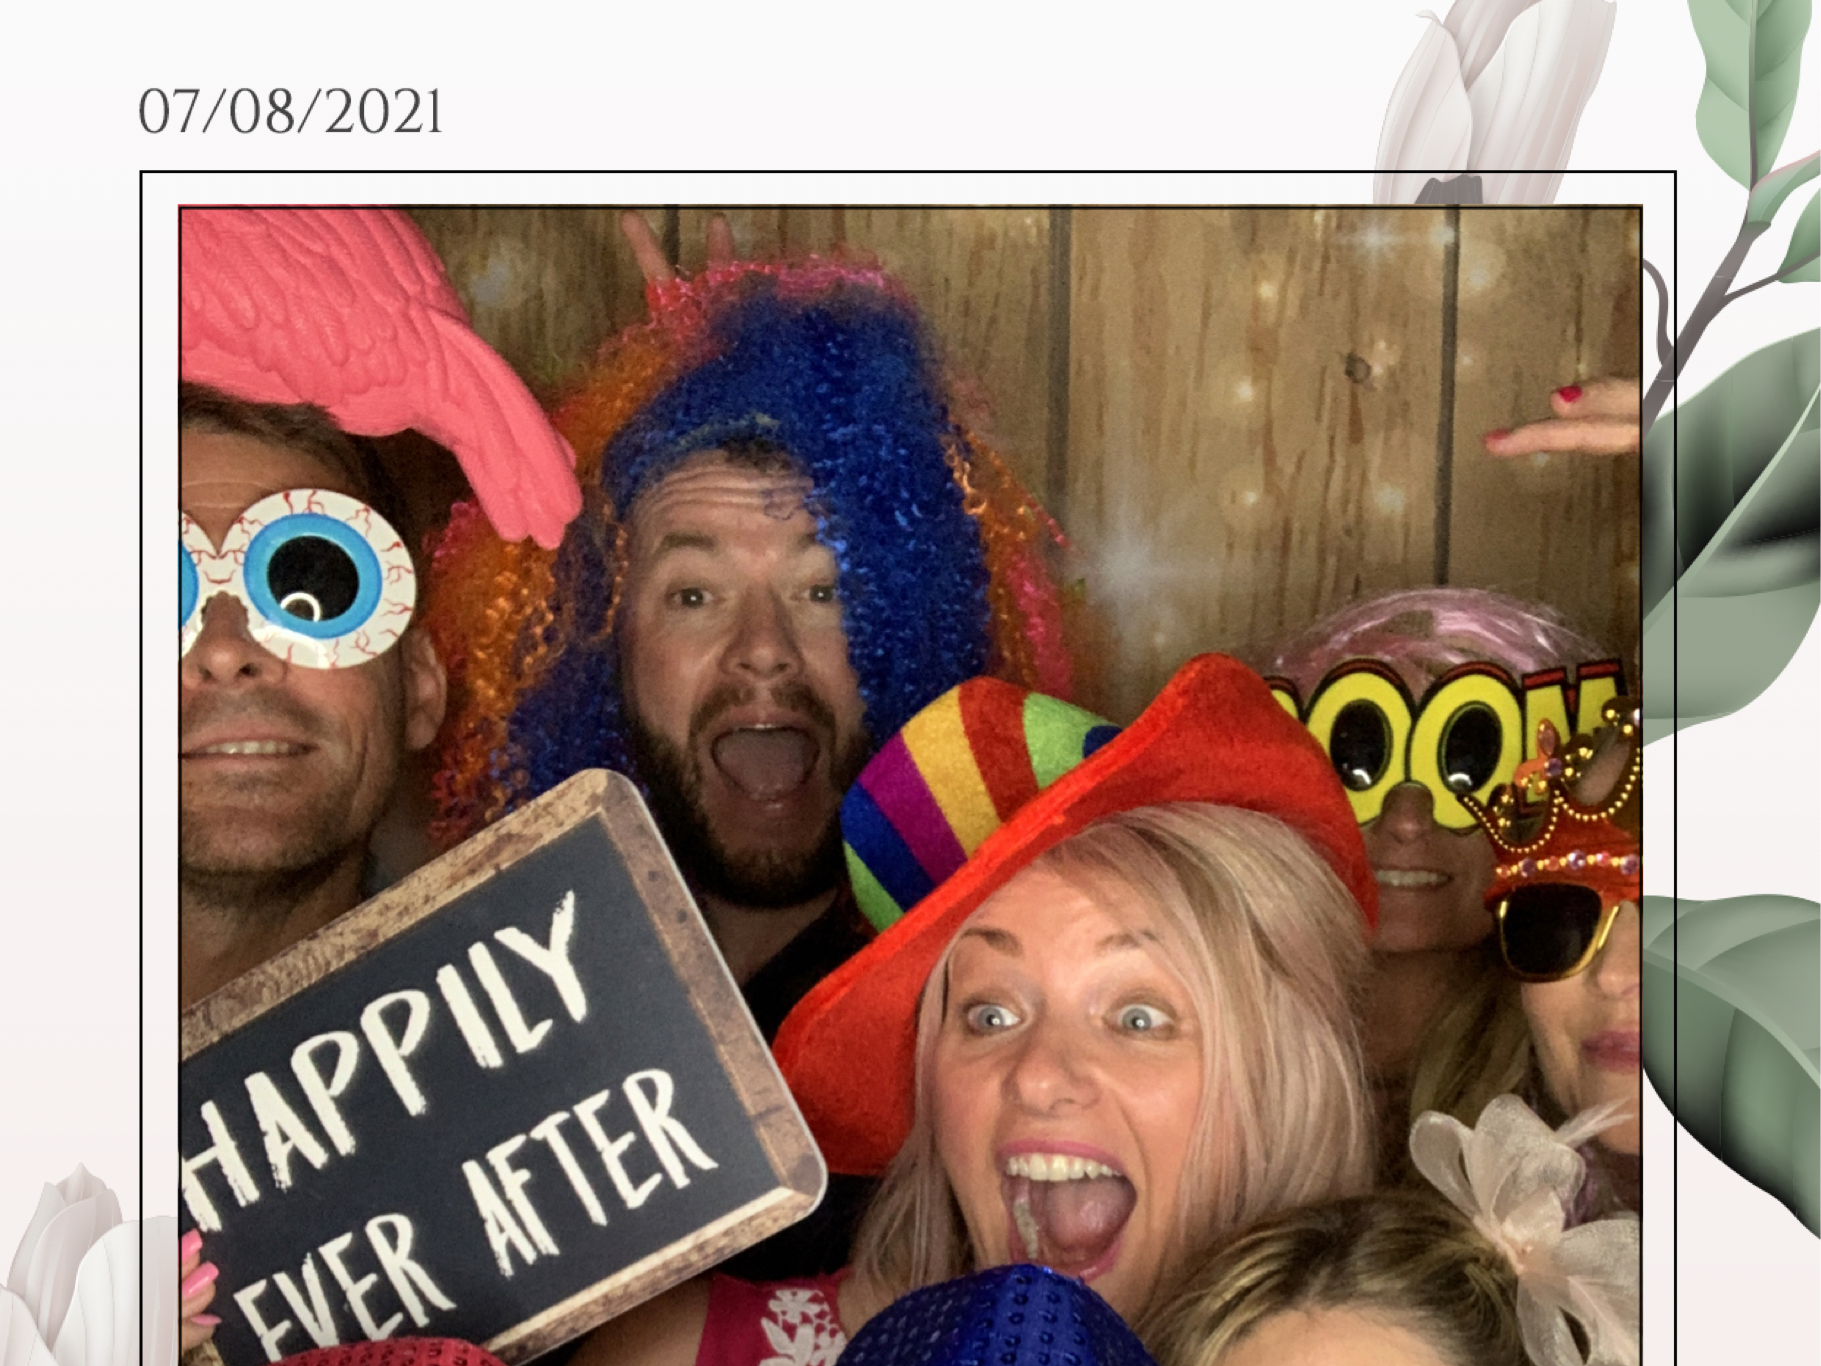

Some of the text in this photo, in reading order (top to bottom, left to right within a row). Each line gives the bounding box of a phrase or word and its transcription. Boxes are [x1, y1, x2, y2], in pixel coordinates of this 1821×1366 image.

[1262, 656, 1632, 836] OOM
[181, 889, 589, 1232] HAPPILY
[232, 1068, 719, 1363] EVER AFTER
